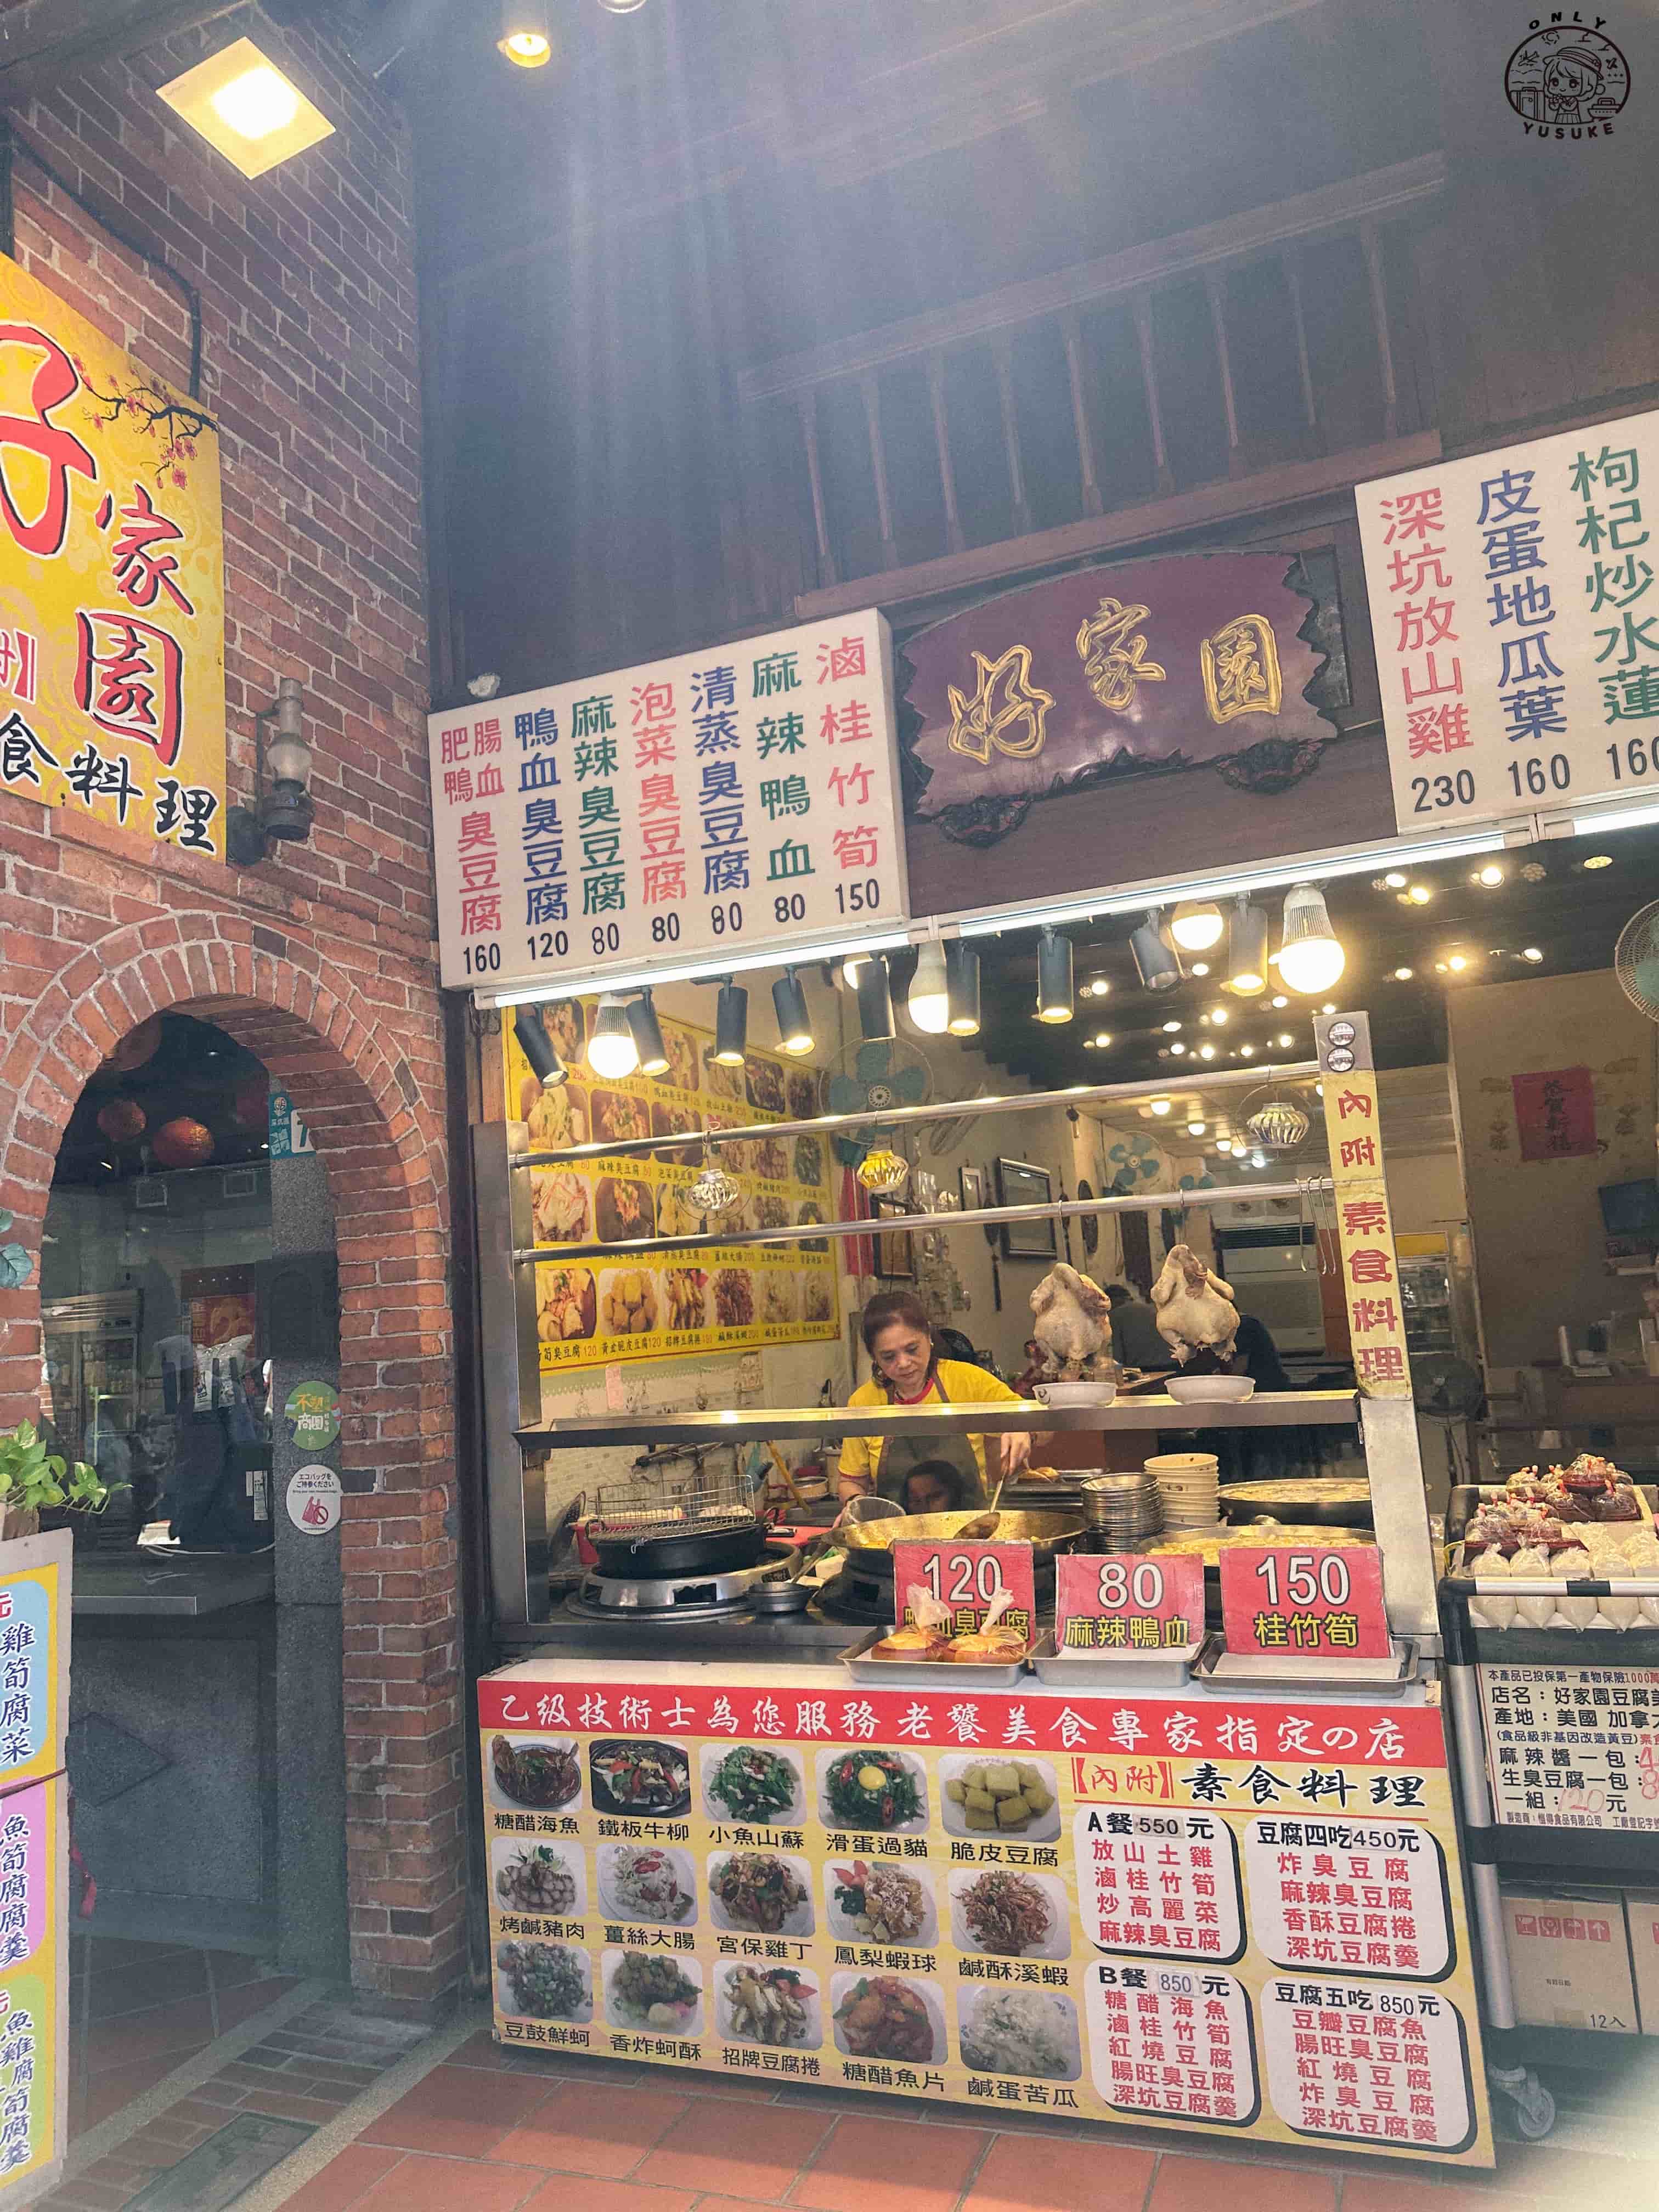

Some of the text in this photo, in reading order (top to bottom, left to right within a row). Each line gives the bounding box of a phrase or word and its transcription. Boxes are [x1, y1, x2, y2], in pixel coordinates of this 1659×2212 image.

[1568, 445, 1659, 725] 枸杞炒水蓮
[1476, 469, 1567, 743] 皮蛋地瓜葉
[1380, 487, 1475, 759] 深坑放山雞
[948, 597, 1282, 765] 好家園
[752, 651, 815, 882] 麻辣鴨血
[816, 636, 879, 870] 滷桂竹筍
[689, 665, 750, 895] 清蒸臭豆腐
[1411, 769, 1476, 813] 230
[1508, 753, 1571, 797] 160
[571, 694, 626, 916] 麻辣臭豆腐
[630, 682, 687, 906] 泡菜臭豆腐
[514, 708, 568, 926] 鴨血臭豆腐
[775, 893, 806, 923] 80
[834, 878, 880, 915] 150
[652, 912, 680, 943] 80
[711, 901, 743, 935] 80
[527, 933, 569, 961] 120
[592, 923, 620, 955] 80
[463, 943, 500, 974] 160
[584, 1345, 597, 1357] 120
[923, 1554, 1002, 1602] 120
[1098, 1562, 1164, 1610] 80
[1256, 1554, 1352, 1606] 150
[1065, 1618, 1190, 1649] 麻辣鴨血
[1255, 1612, 1358, 1647] 桂竹筍
[495, 1813, 579, 1834] 糖醋海魚
[598, 1819, 689, 1841] 鐵板牛柳
[709, 1826, 804, 1849] 小魚山蘇
[826, 1833, 928, 1858] 滑蛋過貓
[951, 1842, 1058, 1866] 脆皮豆腐
[1281, 1880, 1413, 1911] 麻辣臭豆腐
[500, 1916, 585, 1939] 烤鹹豬肉
[603, 1925, 695, 1950] 薑絲大腸
[1099, 1920, 1220, 1952] 麻辣臭豆腐
[1283, 1908, 1417, 1940] 香酥豆腐捲
[716, 1936, 812, 1960] 宮保雞丁
[834, 1945, 937, 1972] 鳳梨蝦球
[1286, 1936, 1419, 1969] 深坑豆腐羹
[958, 1958, 1069, 1986] 鹹酥溪蝦
[504, 2022, 590, 2047] 豆鼓鮮蚵
[1293, 2009, 1427, 2041] 豆瓣豆腐魚
[610, 2035, 701, 2061] 香炸蚵酥
[722, 2047, 821, 2076] 招牌豆腐捲
[1295, 2033, 1429, 2066] 腸旺臭豆腐
[843, 2062, 945, 2092] 糖醋魚片
[967, 2076, 1079, 2108] 鹹蛋苦瓜
[1111, 2061, 1234, 2094] 腸旺臭豆腐
[1114, 2084, 1237, 2118] 深坑豆腐羹
[1302, 2107, 1437, 2142] 深坑豆腐羹
